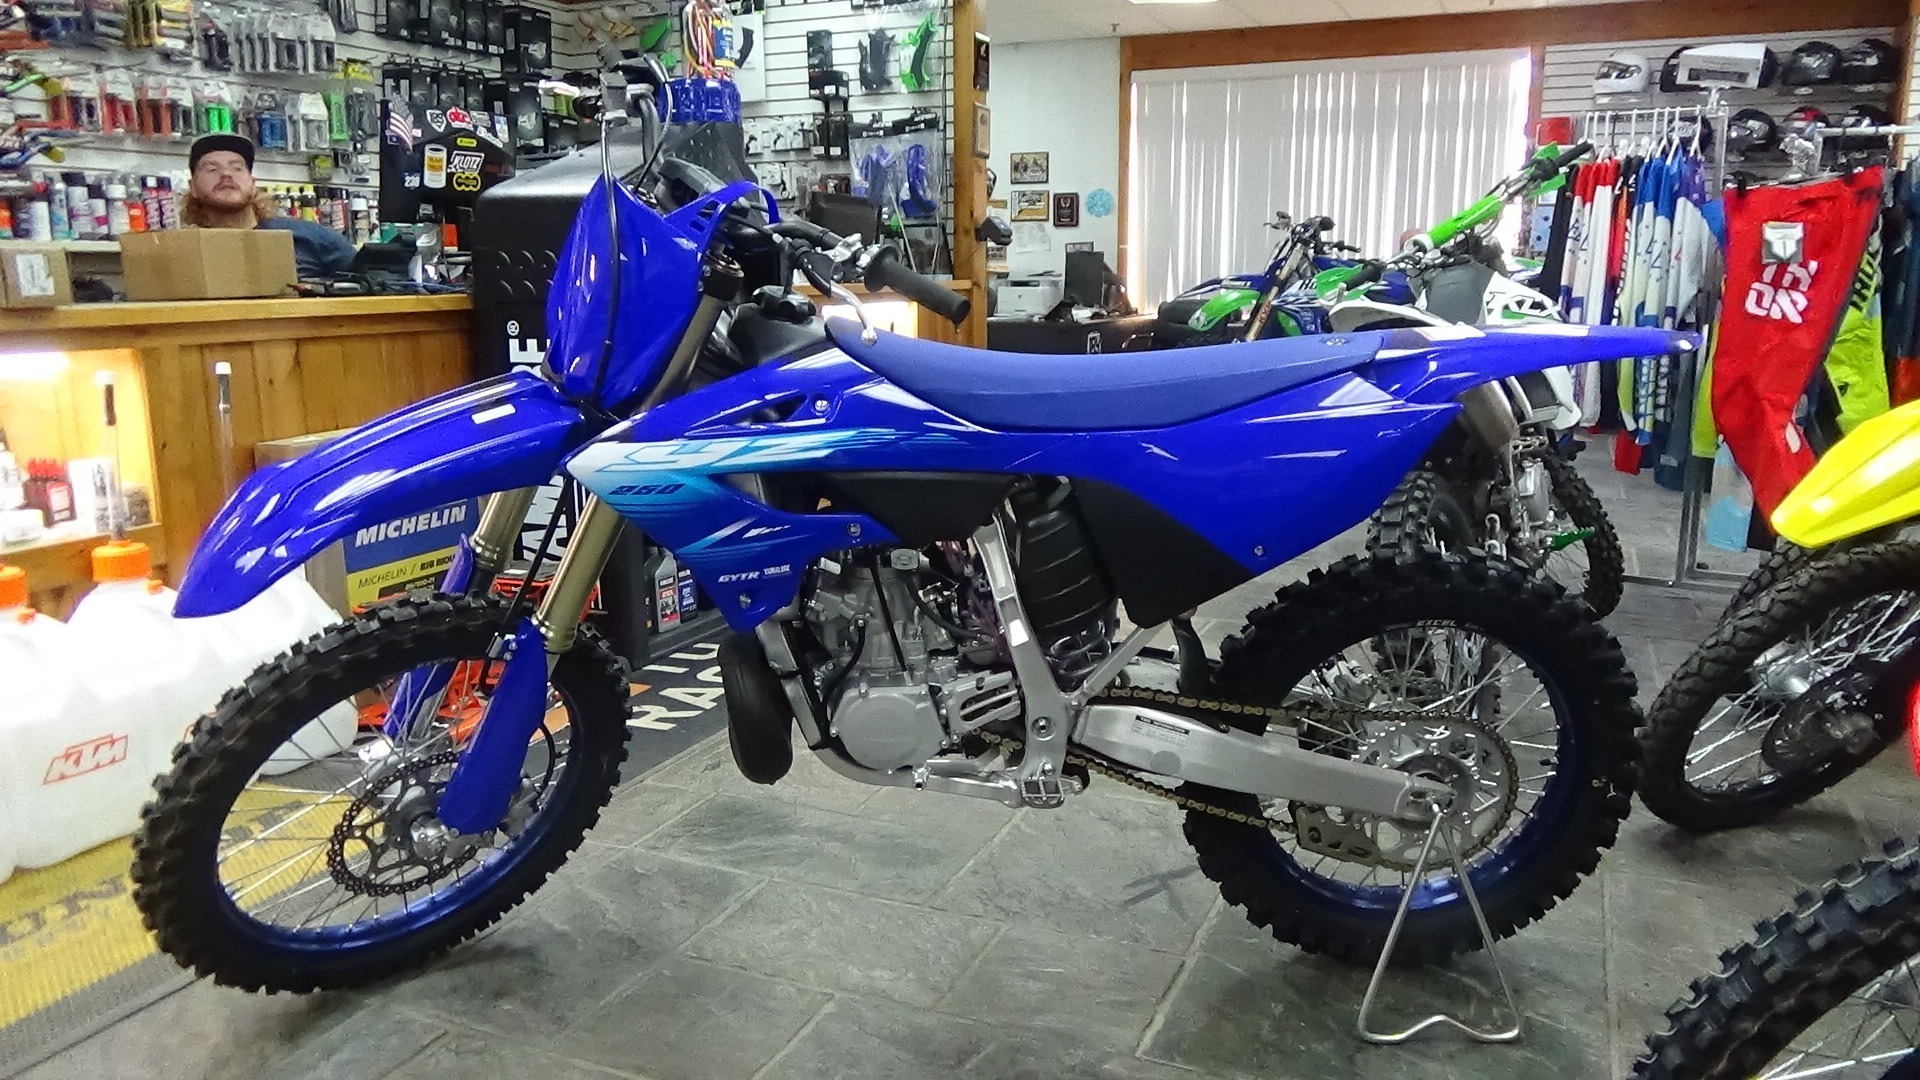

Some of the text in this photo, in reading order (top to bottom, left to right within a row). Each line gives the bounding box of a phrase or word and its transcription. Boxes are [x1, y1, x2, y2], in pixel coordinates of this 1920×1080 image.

[608, 483, 686, 496] 250
[355, 505, 467, 548] MICHELIN
[358, 566, 408, 589] MICHELIN
[718, 570, 760, 583] GYTR
[43, 733, 129, 786] KTM
